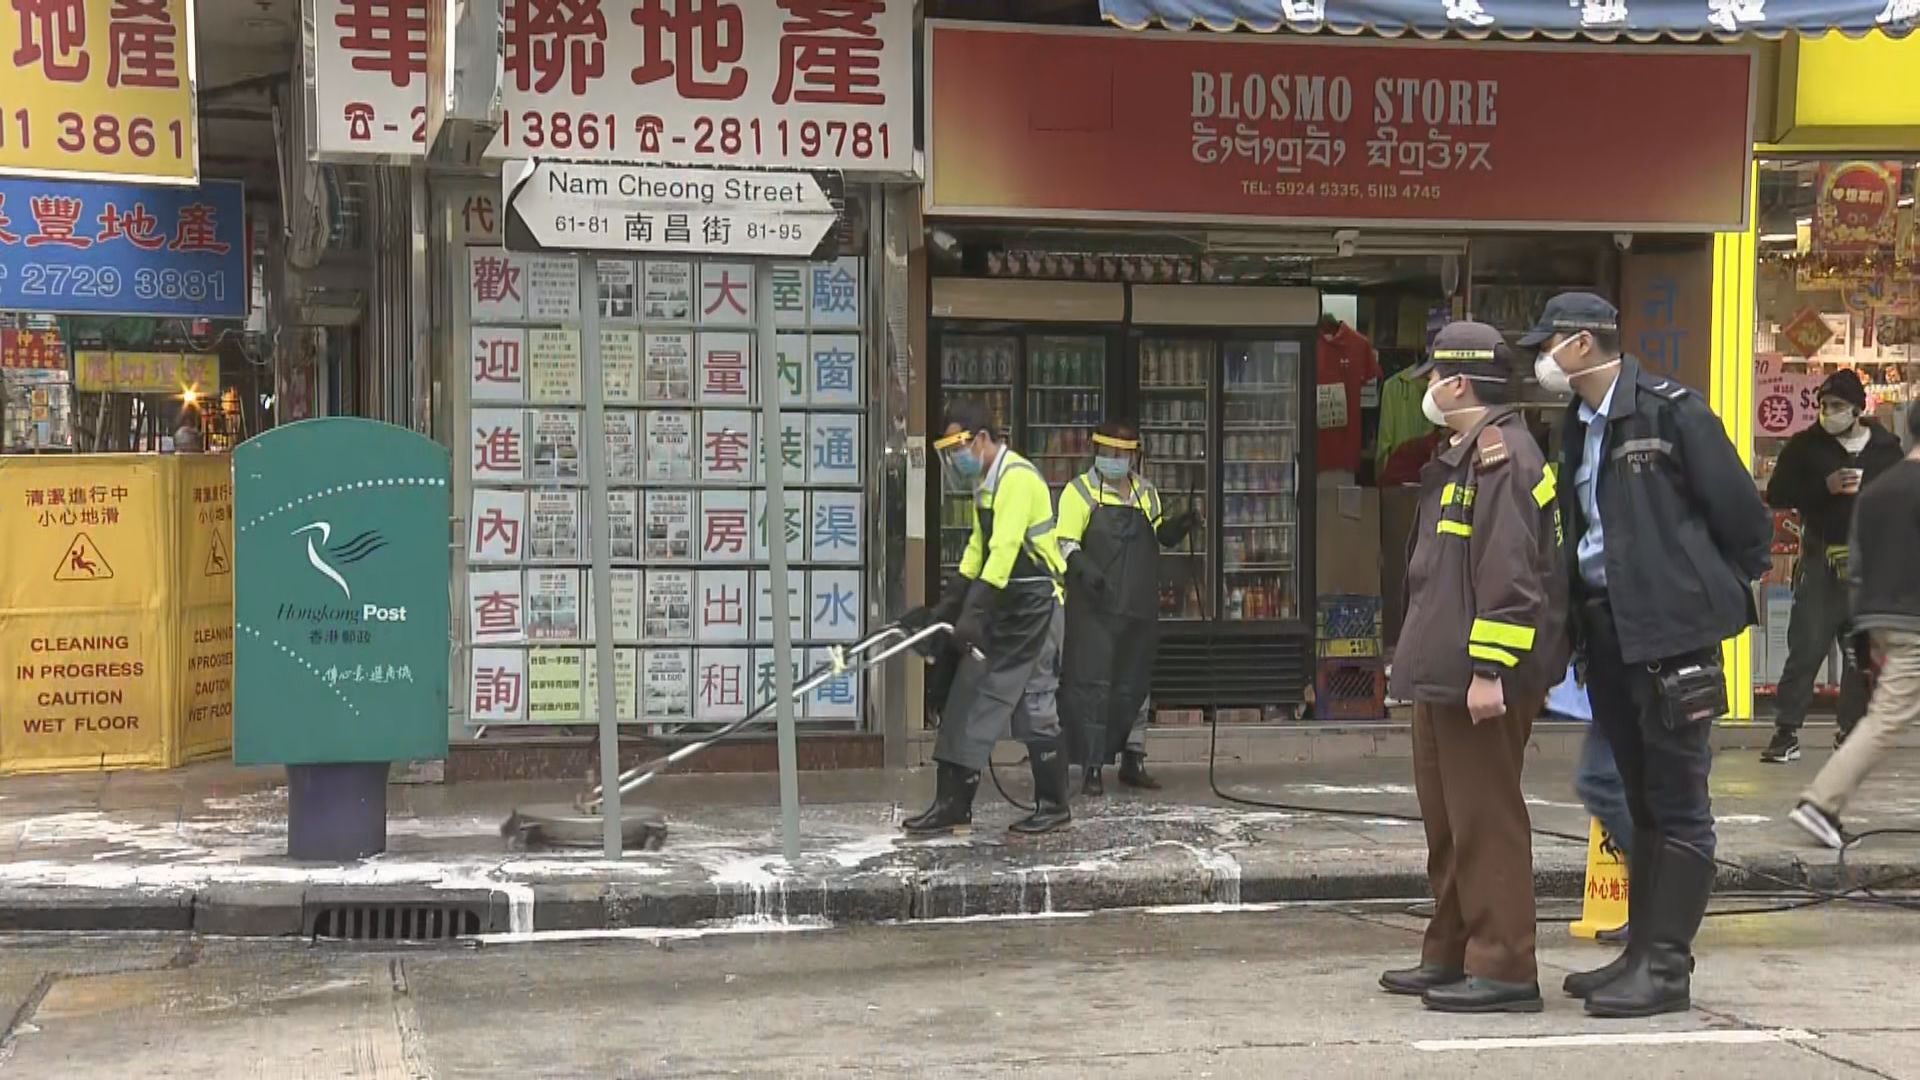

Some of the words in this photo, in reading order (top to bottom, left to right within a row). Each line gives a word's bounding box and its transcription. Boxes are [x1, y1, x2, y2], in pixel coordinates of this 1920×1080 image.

[1191, 71, 1352, 122] BLOSMO
[1374, 77, 1498, 126] STORE
[57, 111, 183, 160] 3861
[548, 171, 608, 196] Nam
[619, 174, 715, 204] Cheong
[724, 178, 804, 203] Street
[1241, 180, 1272, 196] TEL:
[1275, 181, 1315, 197] 5924
[1402, 184, 1441, 200] 4745
[555, 215, 609, 234] 61-81
[624, 212, 731, 246] 南昌街
[747, 221, 802, 241] 81-95
[20, 263, 122, 300] 2729
[134, 266, 226, 300] 3881
[1763, 399, 1789, 428] 送
[25, 485, 129, 508] 清潔進行中
[700, 270, 748, 708] 大量套房出租
[38, 507, 119, 527] 小心地滑
[277, 603, 359, 625] Hongkong
[363, 604, 407, 622] Post
[30, 635, 129, 652] CLEANING
[309, 629, 372, 645] 香港郵政
[17, 664, 36, 681] IN
[40, 662, 145, 681] PROGRESS
[37, 689, 123, 708] CAUTION
[23, 717, 65, 735] WET
[74, 715, 140, 732] FLOOR
